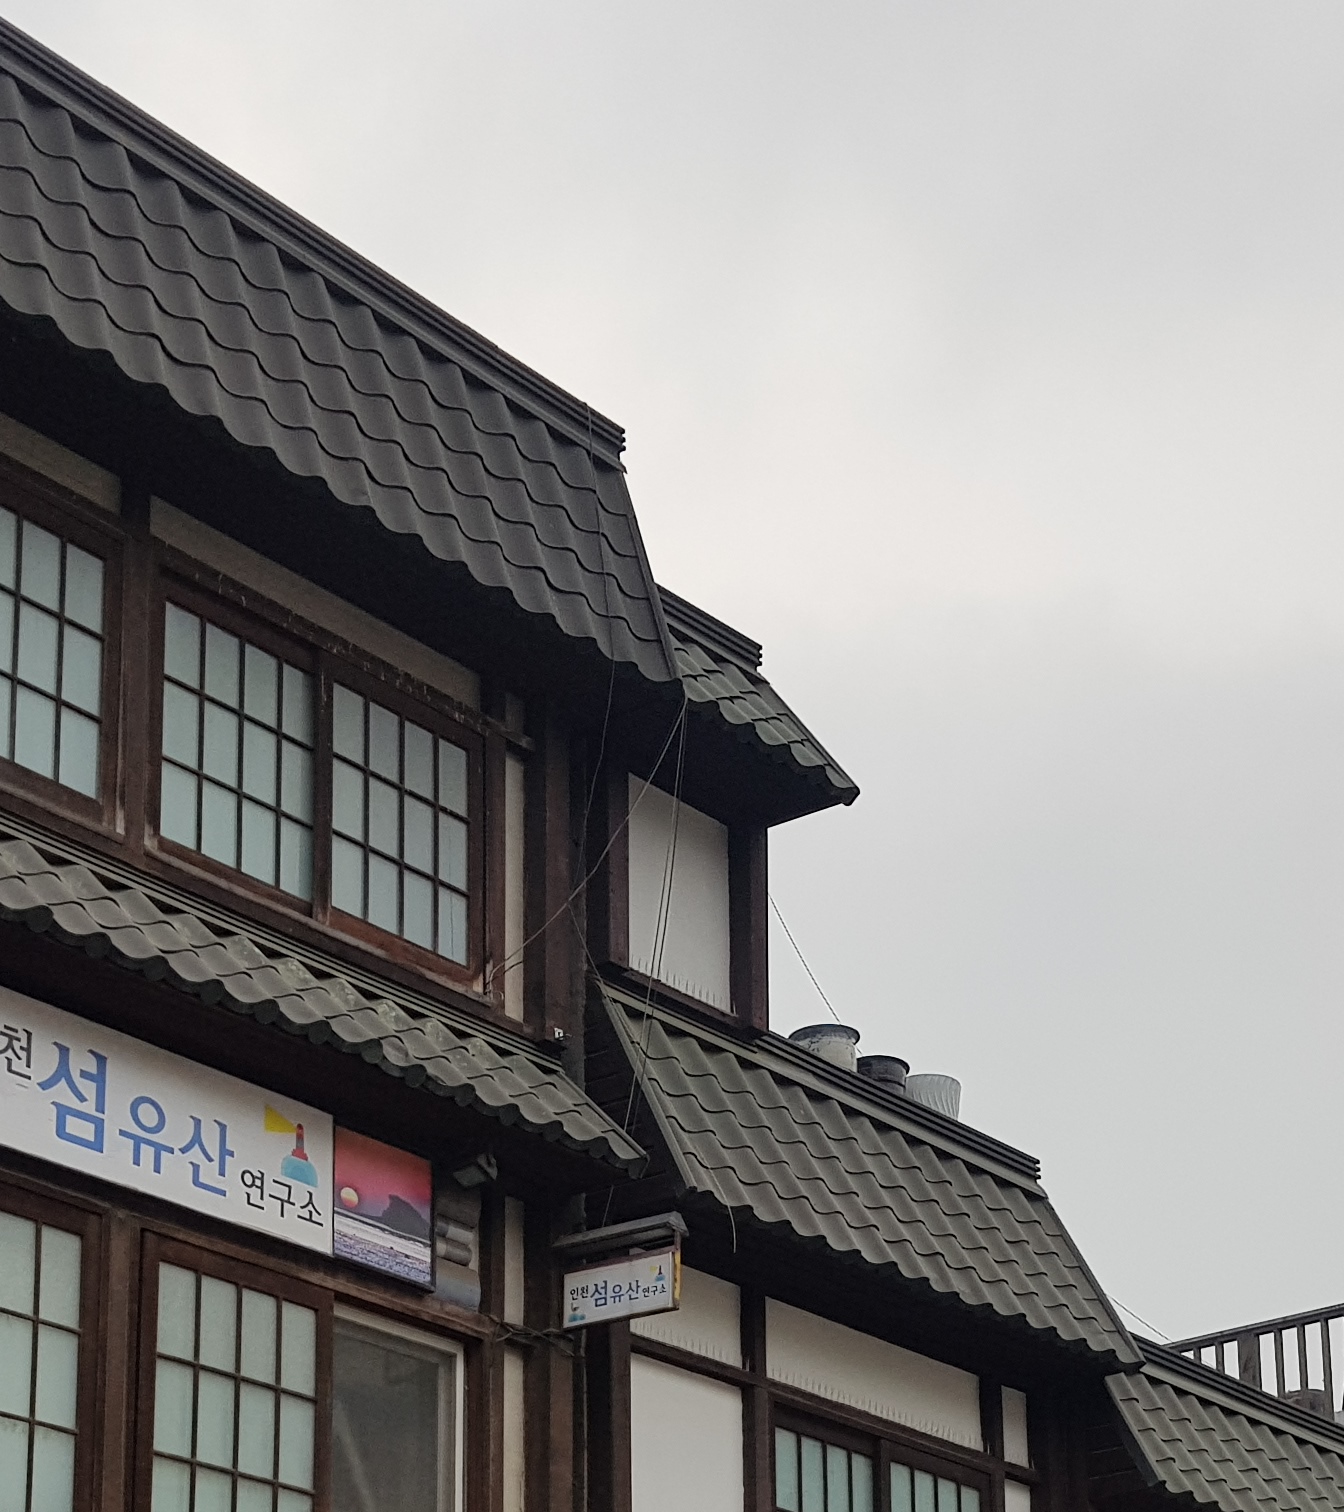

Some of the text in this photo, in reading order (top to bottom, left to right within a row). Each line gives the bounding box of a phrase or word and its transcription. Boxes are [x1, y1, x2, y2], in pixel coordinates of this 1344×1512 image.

[37, 1041, 235, 1198] 섬유산
[240, 1168, 325, 1228] 연구소
[590, 1279, 641, 1308] 섬유산
